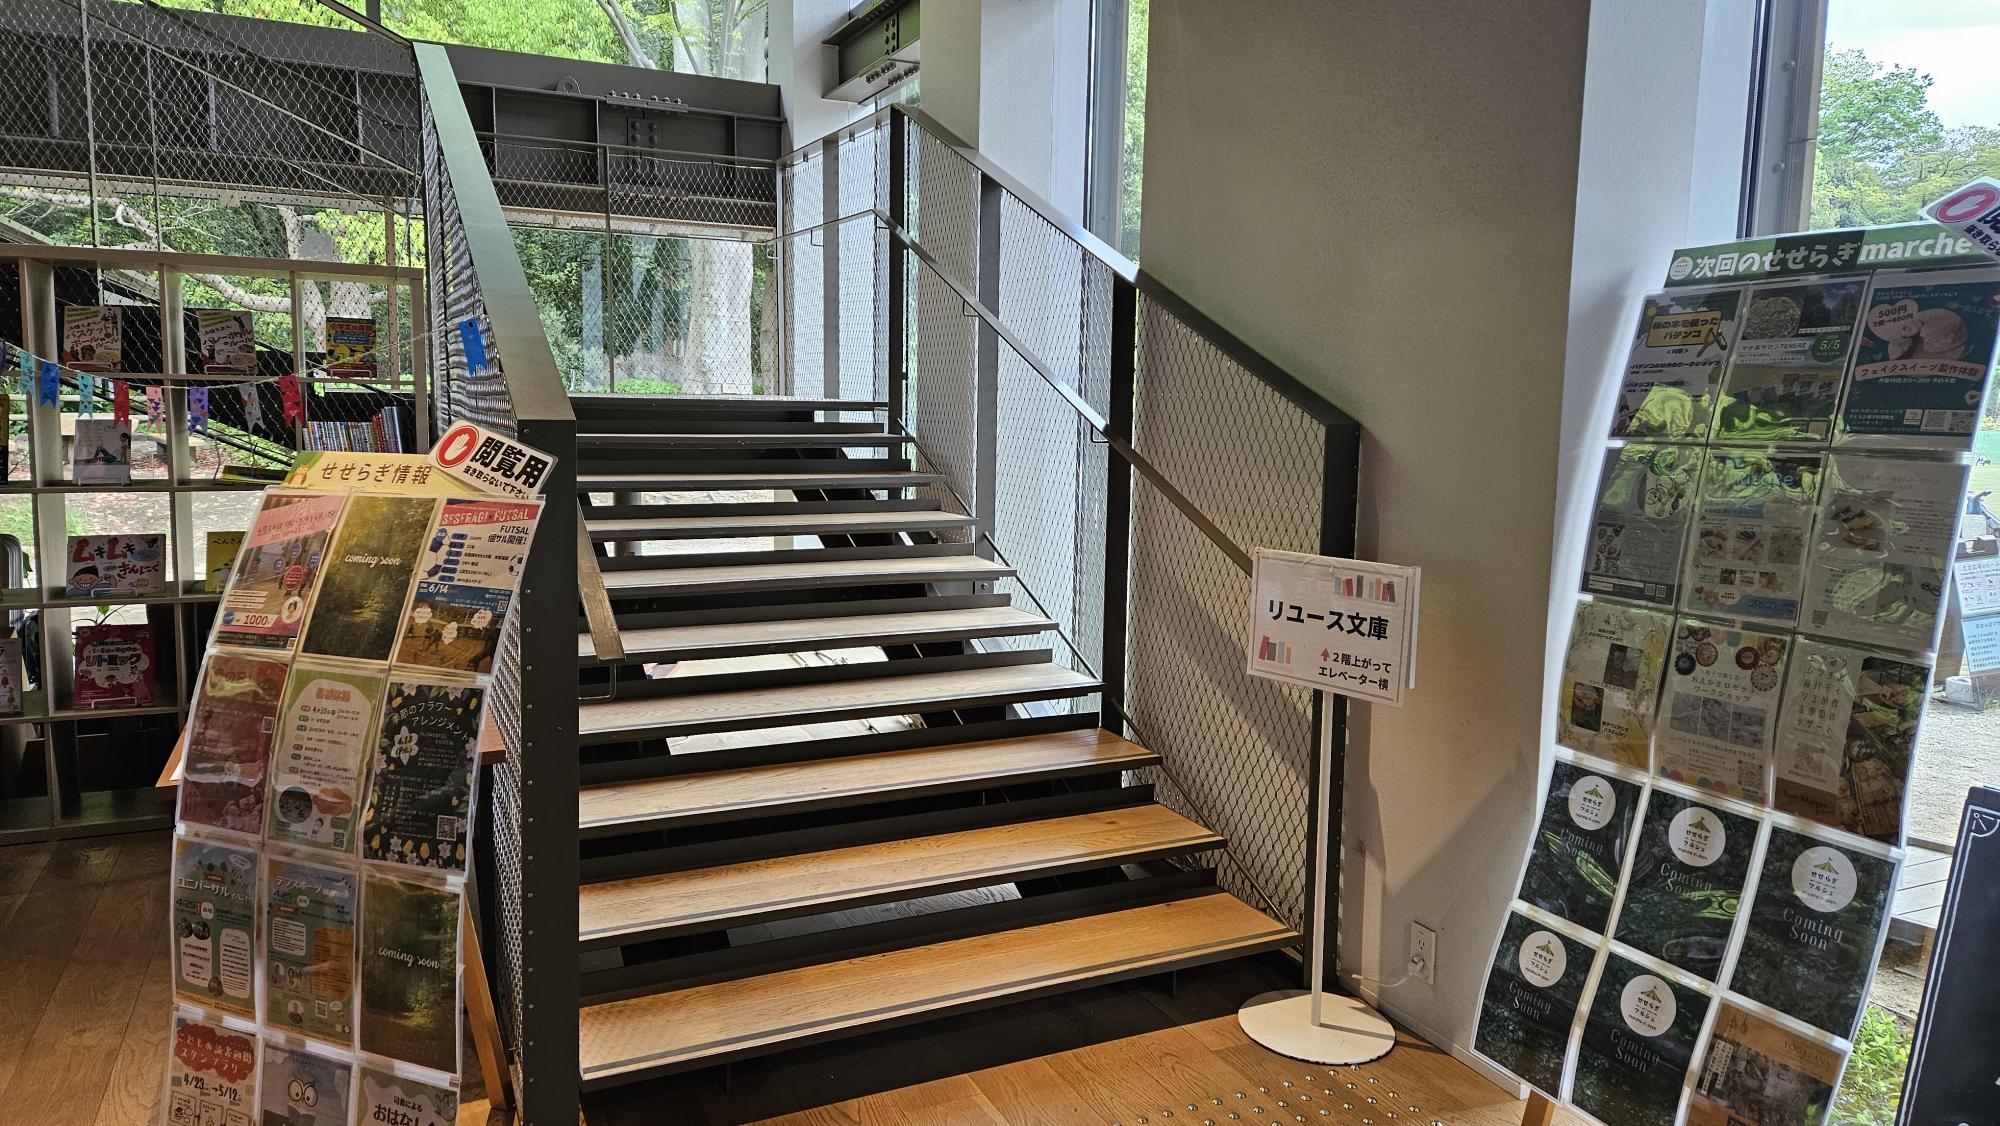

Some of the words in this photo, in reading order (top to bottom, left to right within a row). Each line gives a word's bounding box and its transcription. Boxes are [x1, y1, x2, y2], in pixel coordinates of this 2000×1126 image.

[1964, 223, 2000, 257] 抜き取ら
[1878, 304, 1908, 318] 500円
[1819, 339, 1841, 351] 5/5
[469, 436, 551, 489] 閲覧用
[320, 462, 432, 485] せせらぎ情報
[462, 466, 530, 499] 抜き取らないで下さい
[493, 508, 529, 521] FUTSAL
[499, 525, 530, 535] FUTSAL
[72, 536, 136, 563] ムキムキ
[116, 561, 159, 580] きんにく
[344, 553, 378, 568] coming
[380, 556, 402, 566] soon
[427, 583, 448, 593] 6/14
[243, 614, 270, 626] 1000
[1268, 599, 1390, 641] リユース文庫
[86, 652, 142, 667] リトミック
[1332, 652, 1392, 674] 2階上がって
[1317, 666, 1389, 691] エレベーター横
[1580, 806, 1599, 817] マルシェ
[1582, 796, 1603, 808] せせらぎ
[1560, 827, 1604, 856] Coming
[1686, 829, 1710, 842] せせらぎ
[1682, 840, 1706, 852] マルシェ
[176, 876, 230, 897] ユニバーサル
[1660, 862, 1713, 893] Coming
[1810, 870, 1840, 885] せせらぎ
[1808, 881, 1834, 896] マルシェ
[1783, 907, 1843, 943] Coming
[1789, 924, 1829, 951] Soon
[378, 946, 415, 968] coming
[416, 954, 440, 970] soon
[1532, 950, 1553, 965] せせらぎ
[1530, 961, 1549, 975] マルシェ
[1509, 980, 1552, 1015] Coming
[1637, 997, 1661, 1011] せせらぎ
[1513, 996, 1541, 1022] Soon
[1634, 1007, 1656, 1022] マルシェ
[1610, 1028, 1660, 1067] Coming
[1615, 1045, 1647, 1074] Soon
[373, 1103, 436, 1126] おはなし
